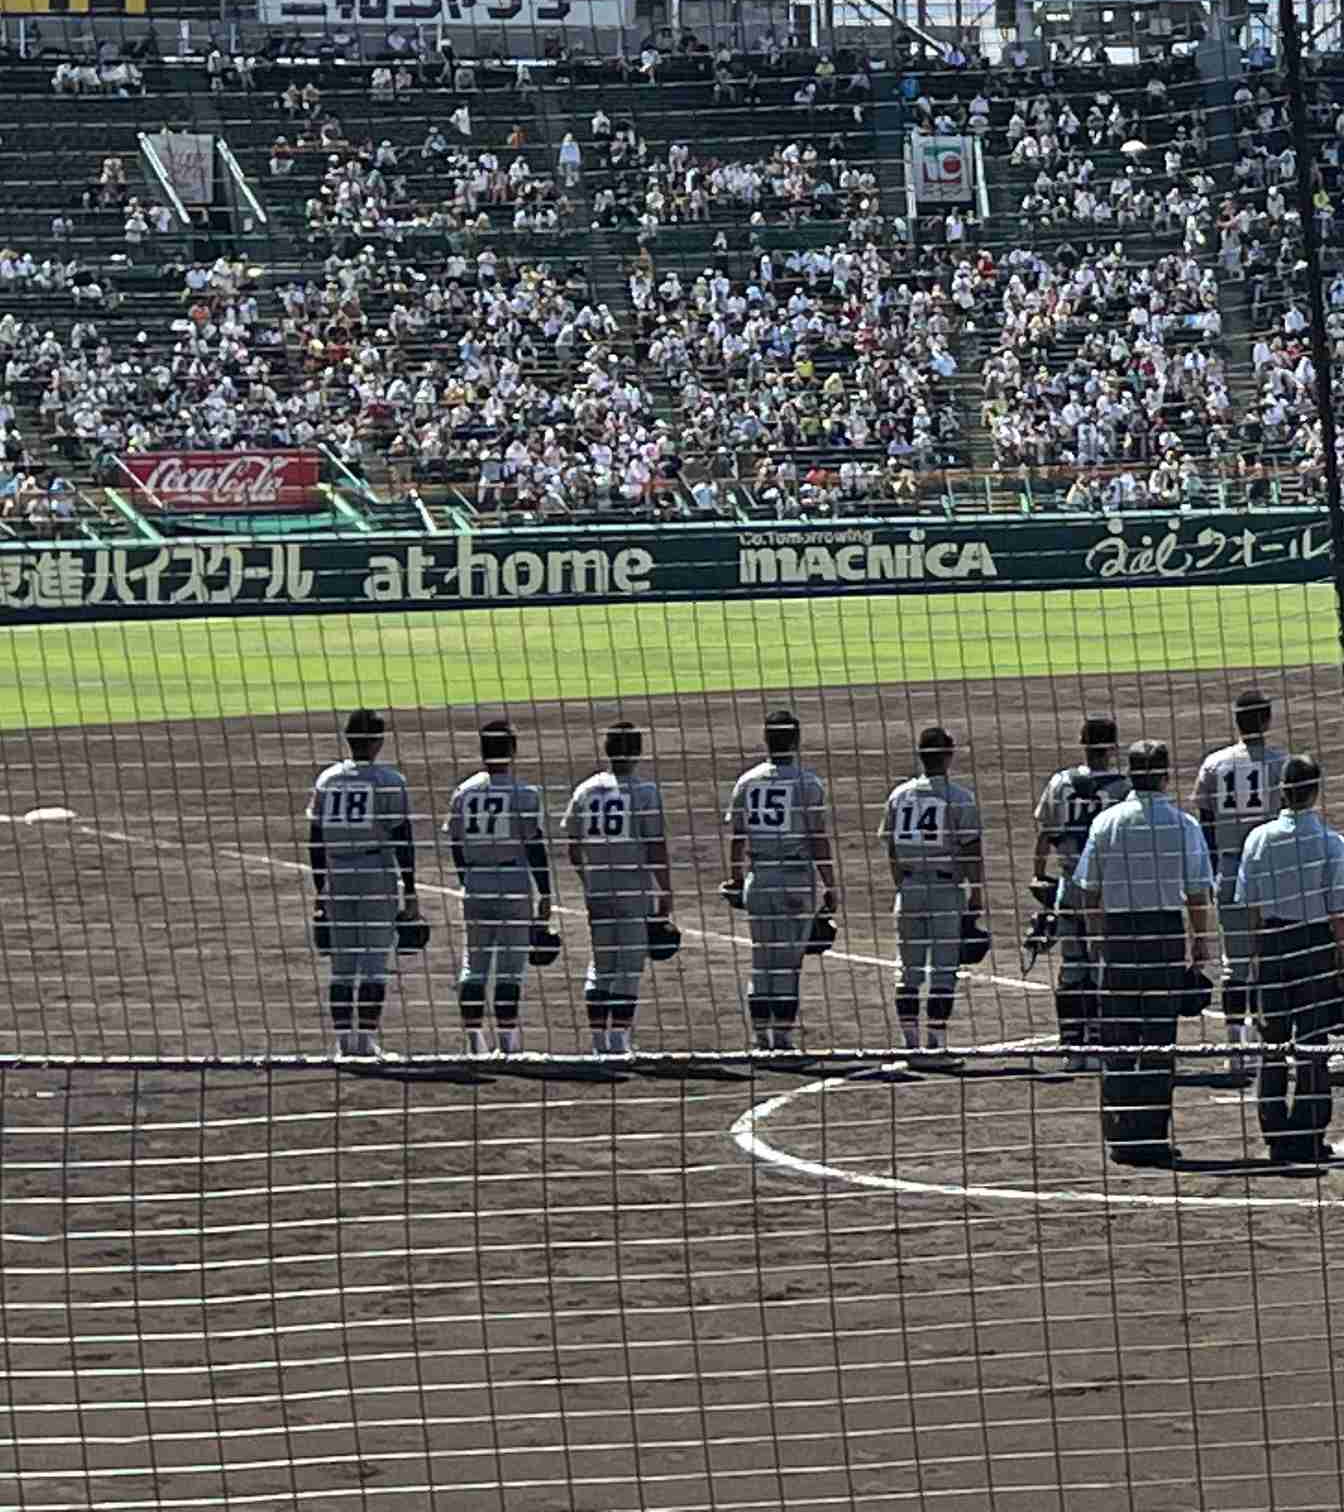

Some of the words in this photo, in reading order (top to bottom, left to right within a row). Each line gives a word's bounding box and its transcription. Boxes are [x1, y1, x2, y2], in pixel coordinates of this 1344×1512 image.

[363, 545, 437, 601] at
[455, 536, 653, 598] home
[329, 792, 368, 824] 18
[748, 789, 785, 826] 15
[1223, 771, 1264, 809] 11
[467, 797, 504, 833] 17
[587, 799, 624, 835] 16
[900, 807, 937, 846] 14
